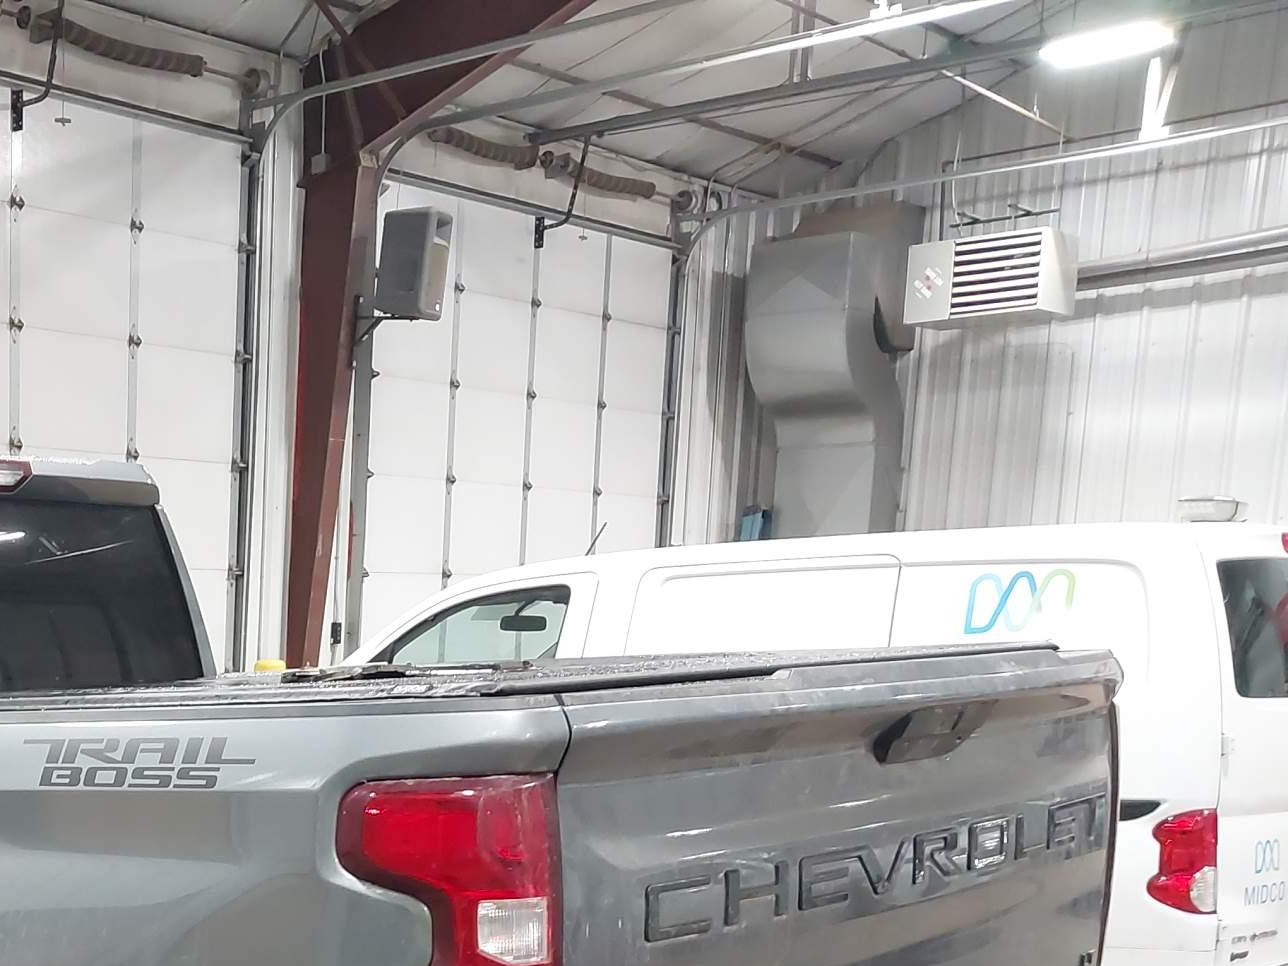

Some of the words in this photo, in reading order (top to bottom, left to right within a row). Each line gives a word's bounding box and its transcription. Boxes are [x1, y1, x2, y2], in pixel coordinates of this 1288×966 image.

[23, 737, 257, 765] TRAIL
[39, 766, 220, 789] BOSS
[644, 792, 1106, 943] CHEVROLET
